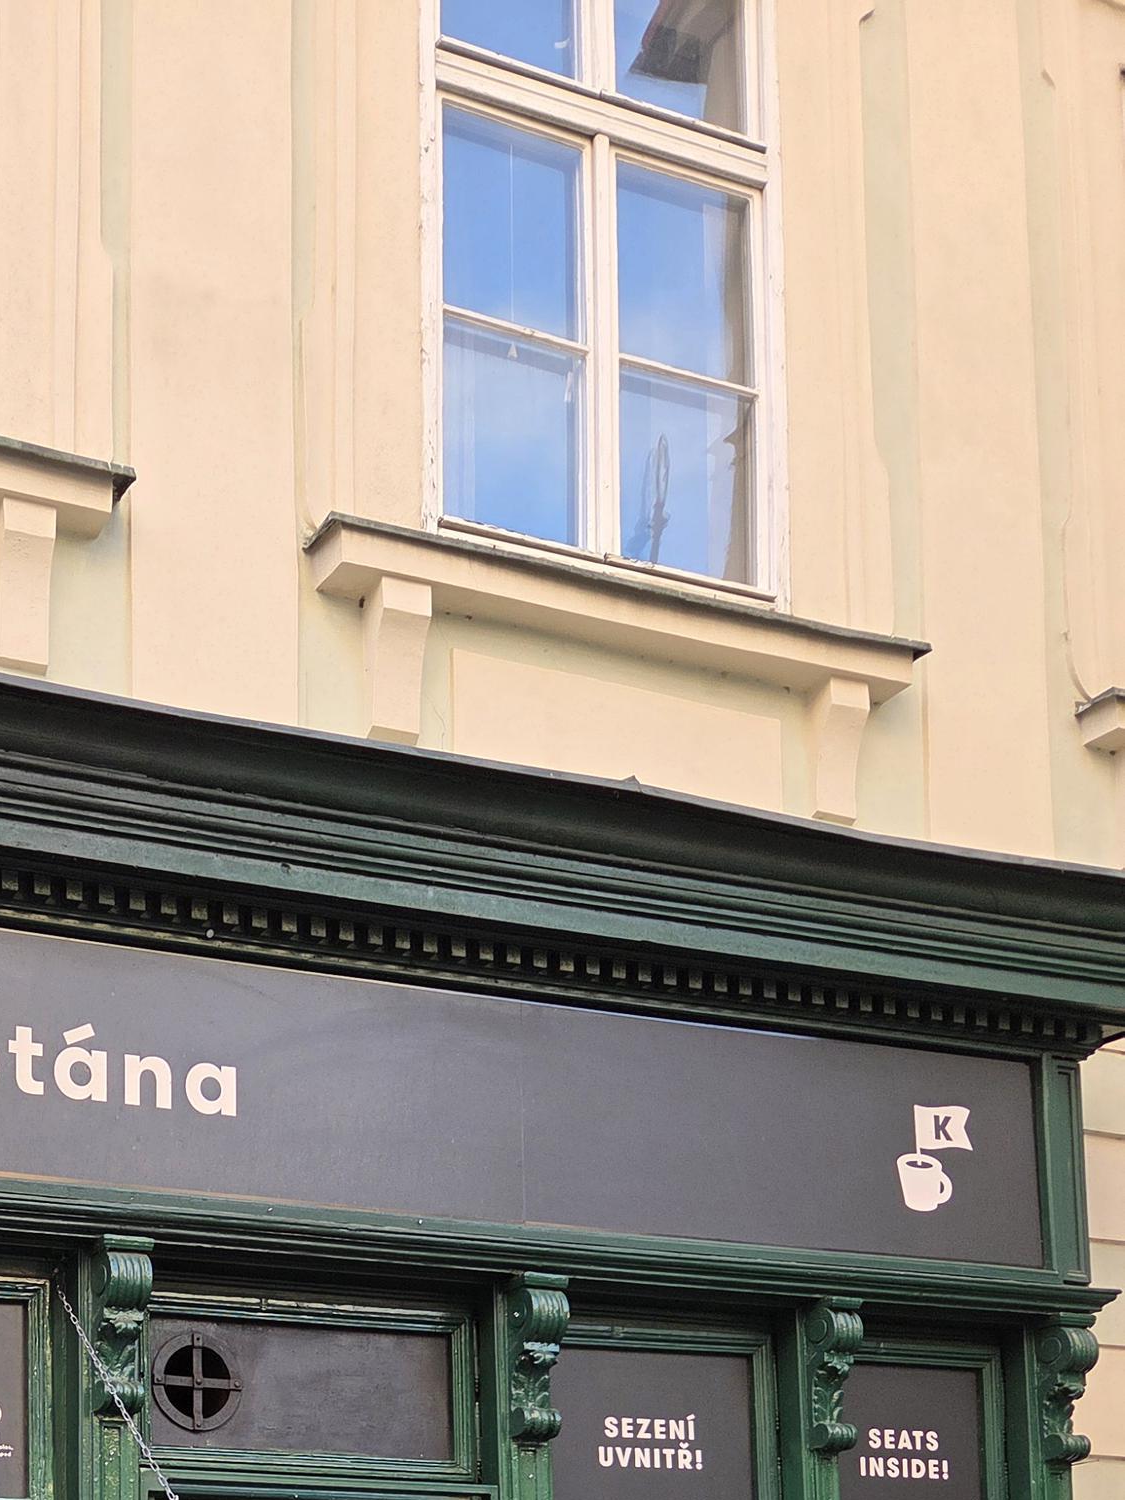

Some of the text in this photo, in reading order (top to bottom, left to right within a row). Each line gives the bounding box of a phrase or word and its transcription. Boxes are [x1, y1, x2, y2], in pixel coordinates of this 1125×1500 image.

[933, 1115, 953, 1141] K
[604, 1413, 695, 1441] SEZENÍ
[868, 1428, 939, 1452] SEATS
[598, 1442, 703, 1471] UVNITŘ!
[859, 1455, 949, 1480] INSIDE!
